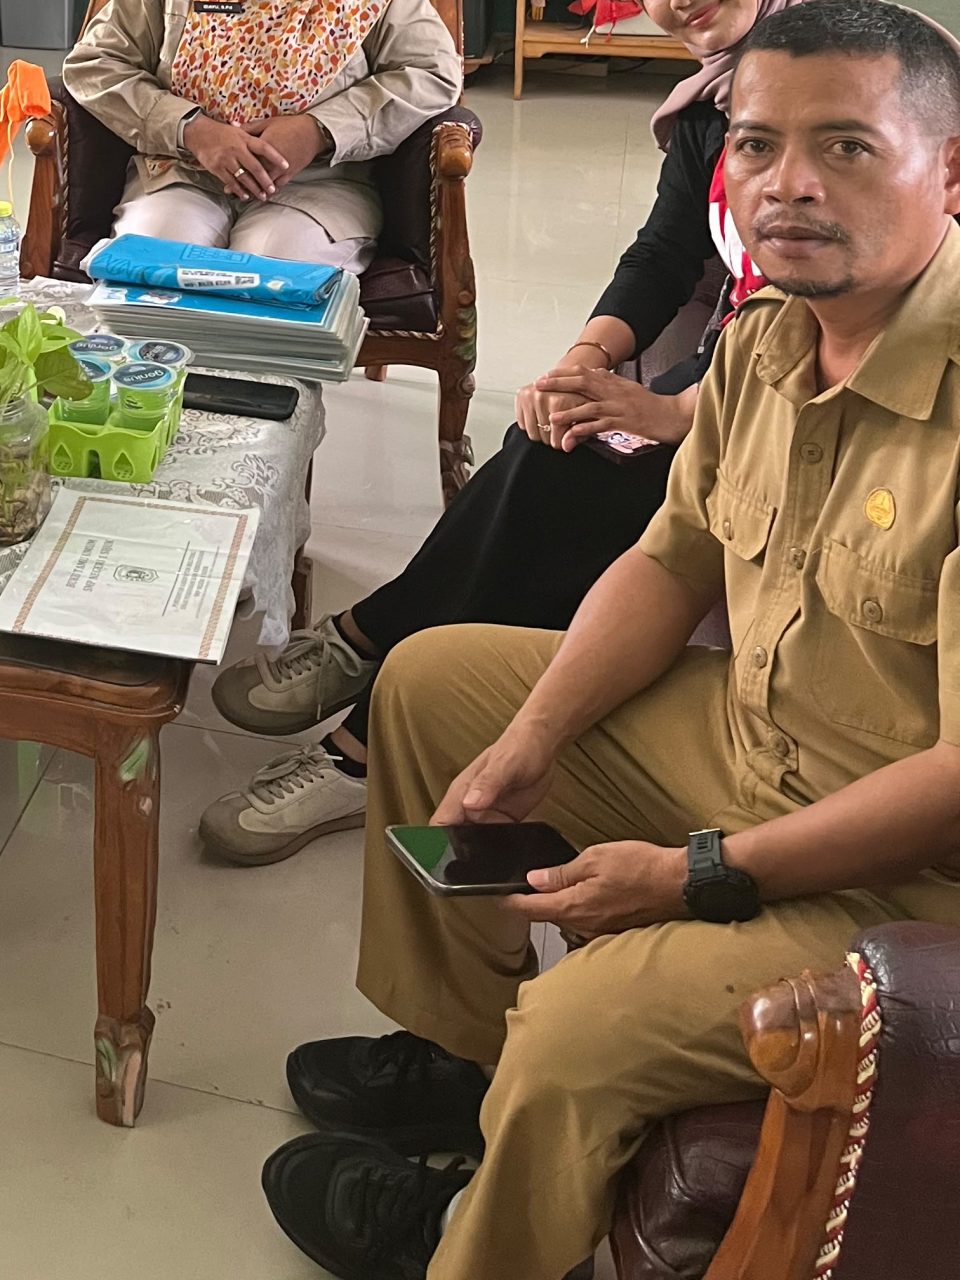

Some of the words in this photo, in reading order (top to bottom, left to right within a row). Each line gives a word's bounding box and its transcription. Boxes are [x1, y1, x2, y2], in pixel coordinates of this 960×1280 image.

[123, 369, 165, 383] genius
[83, 580, 95, 592] SMP
[89, 560, 105, 580] NEGERI
